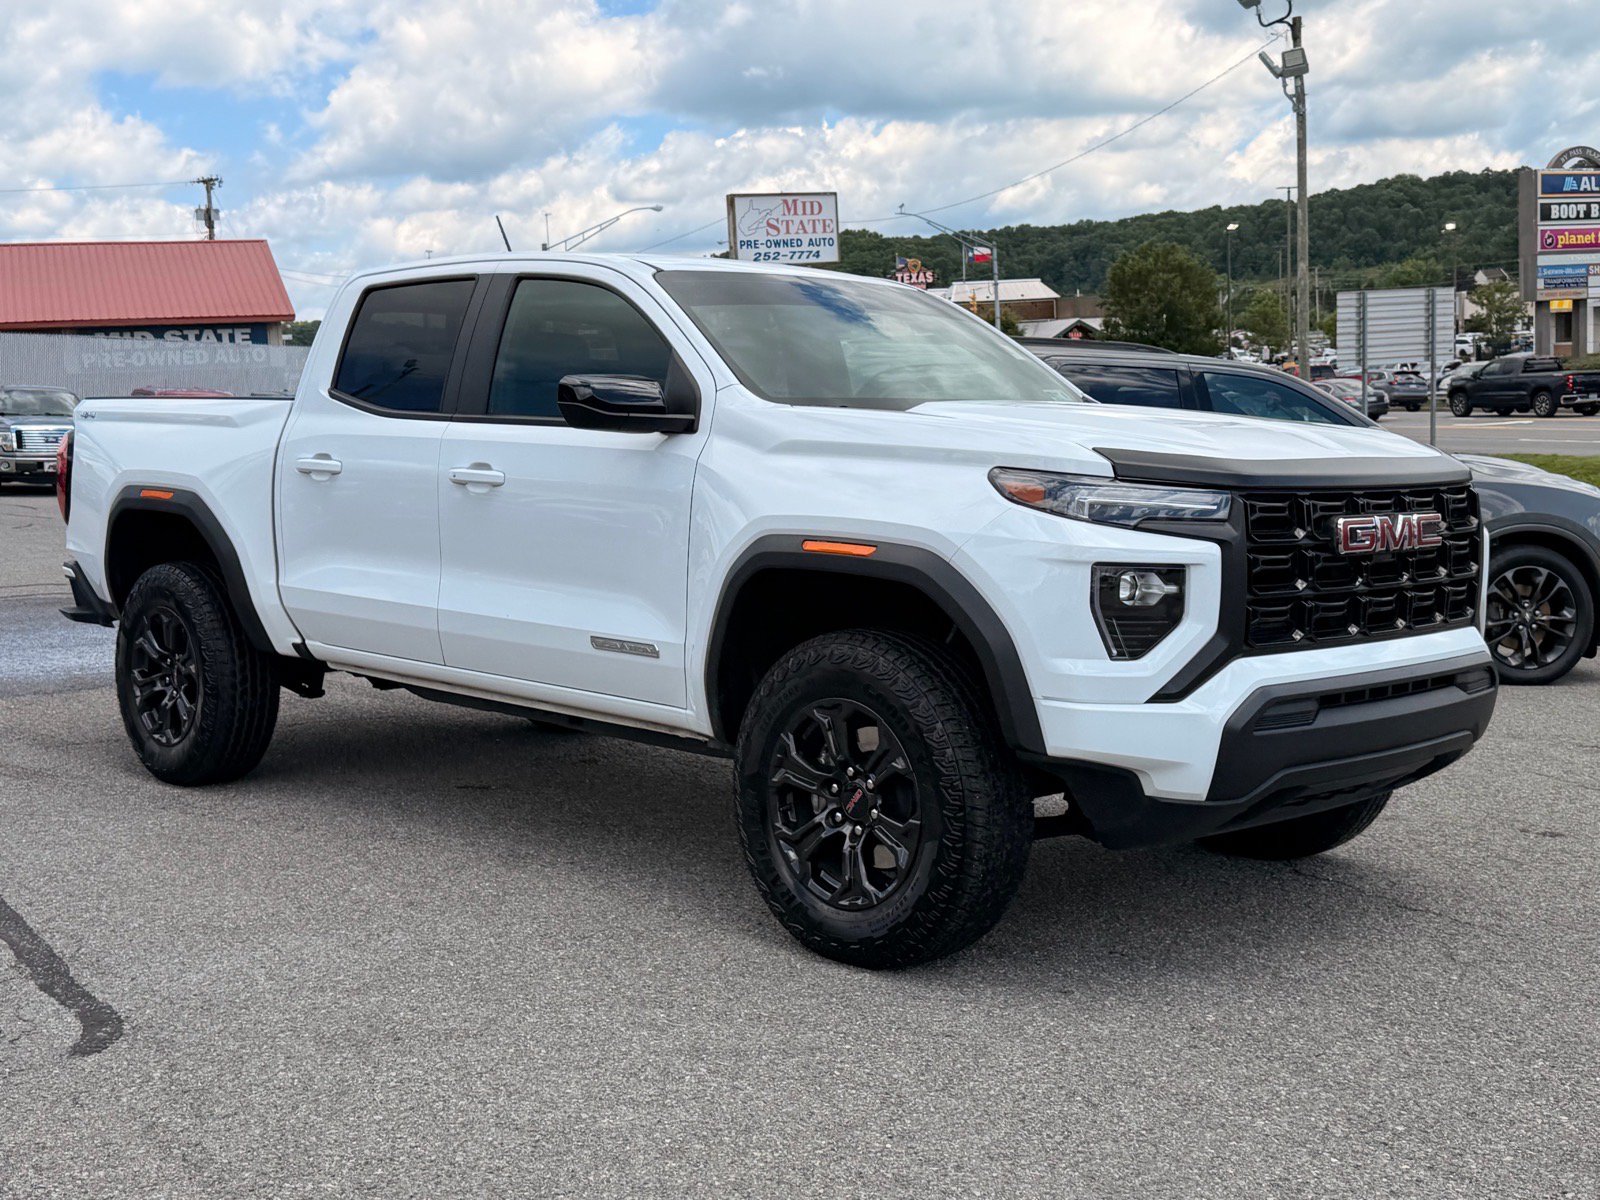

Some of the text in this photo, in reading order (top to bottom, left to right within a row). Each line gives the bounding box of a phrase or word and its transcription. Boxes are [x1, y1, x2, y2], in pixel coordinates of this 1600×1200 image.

[1579, 176, 1600, 191] AL
[781, 198, 823, 216] MID
[1550, 203, 1587, 219] BOOT
[766, 217, 834, 238] STATE
[739, 237, 835, 250] PRE-OWNED AUTO
[1557, 231, 1596, 248] planet
[753, 250, 820, 261] 252-7774
[896, 272, 933, 284] TEXAS
[163, 328, 252, 346] STATE
[214, 347, 267, 364] AUTO
[1337, 513, 1443, 554] GMC
